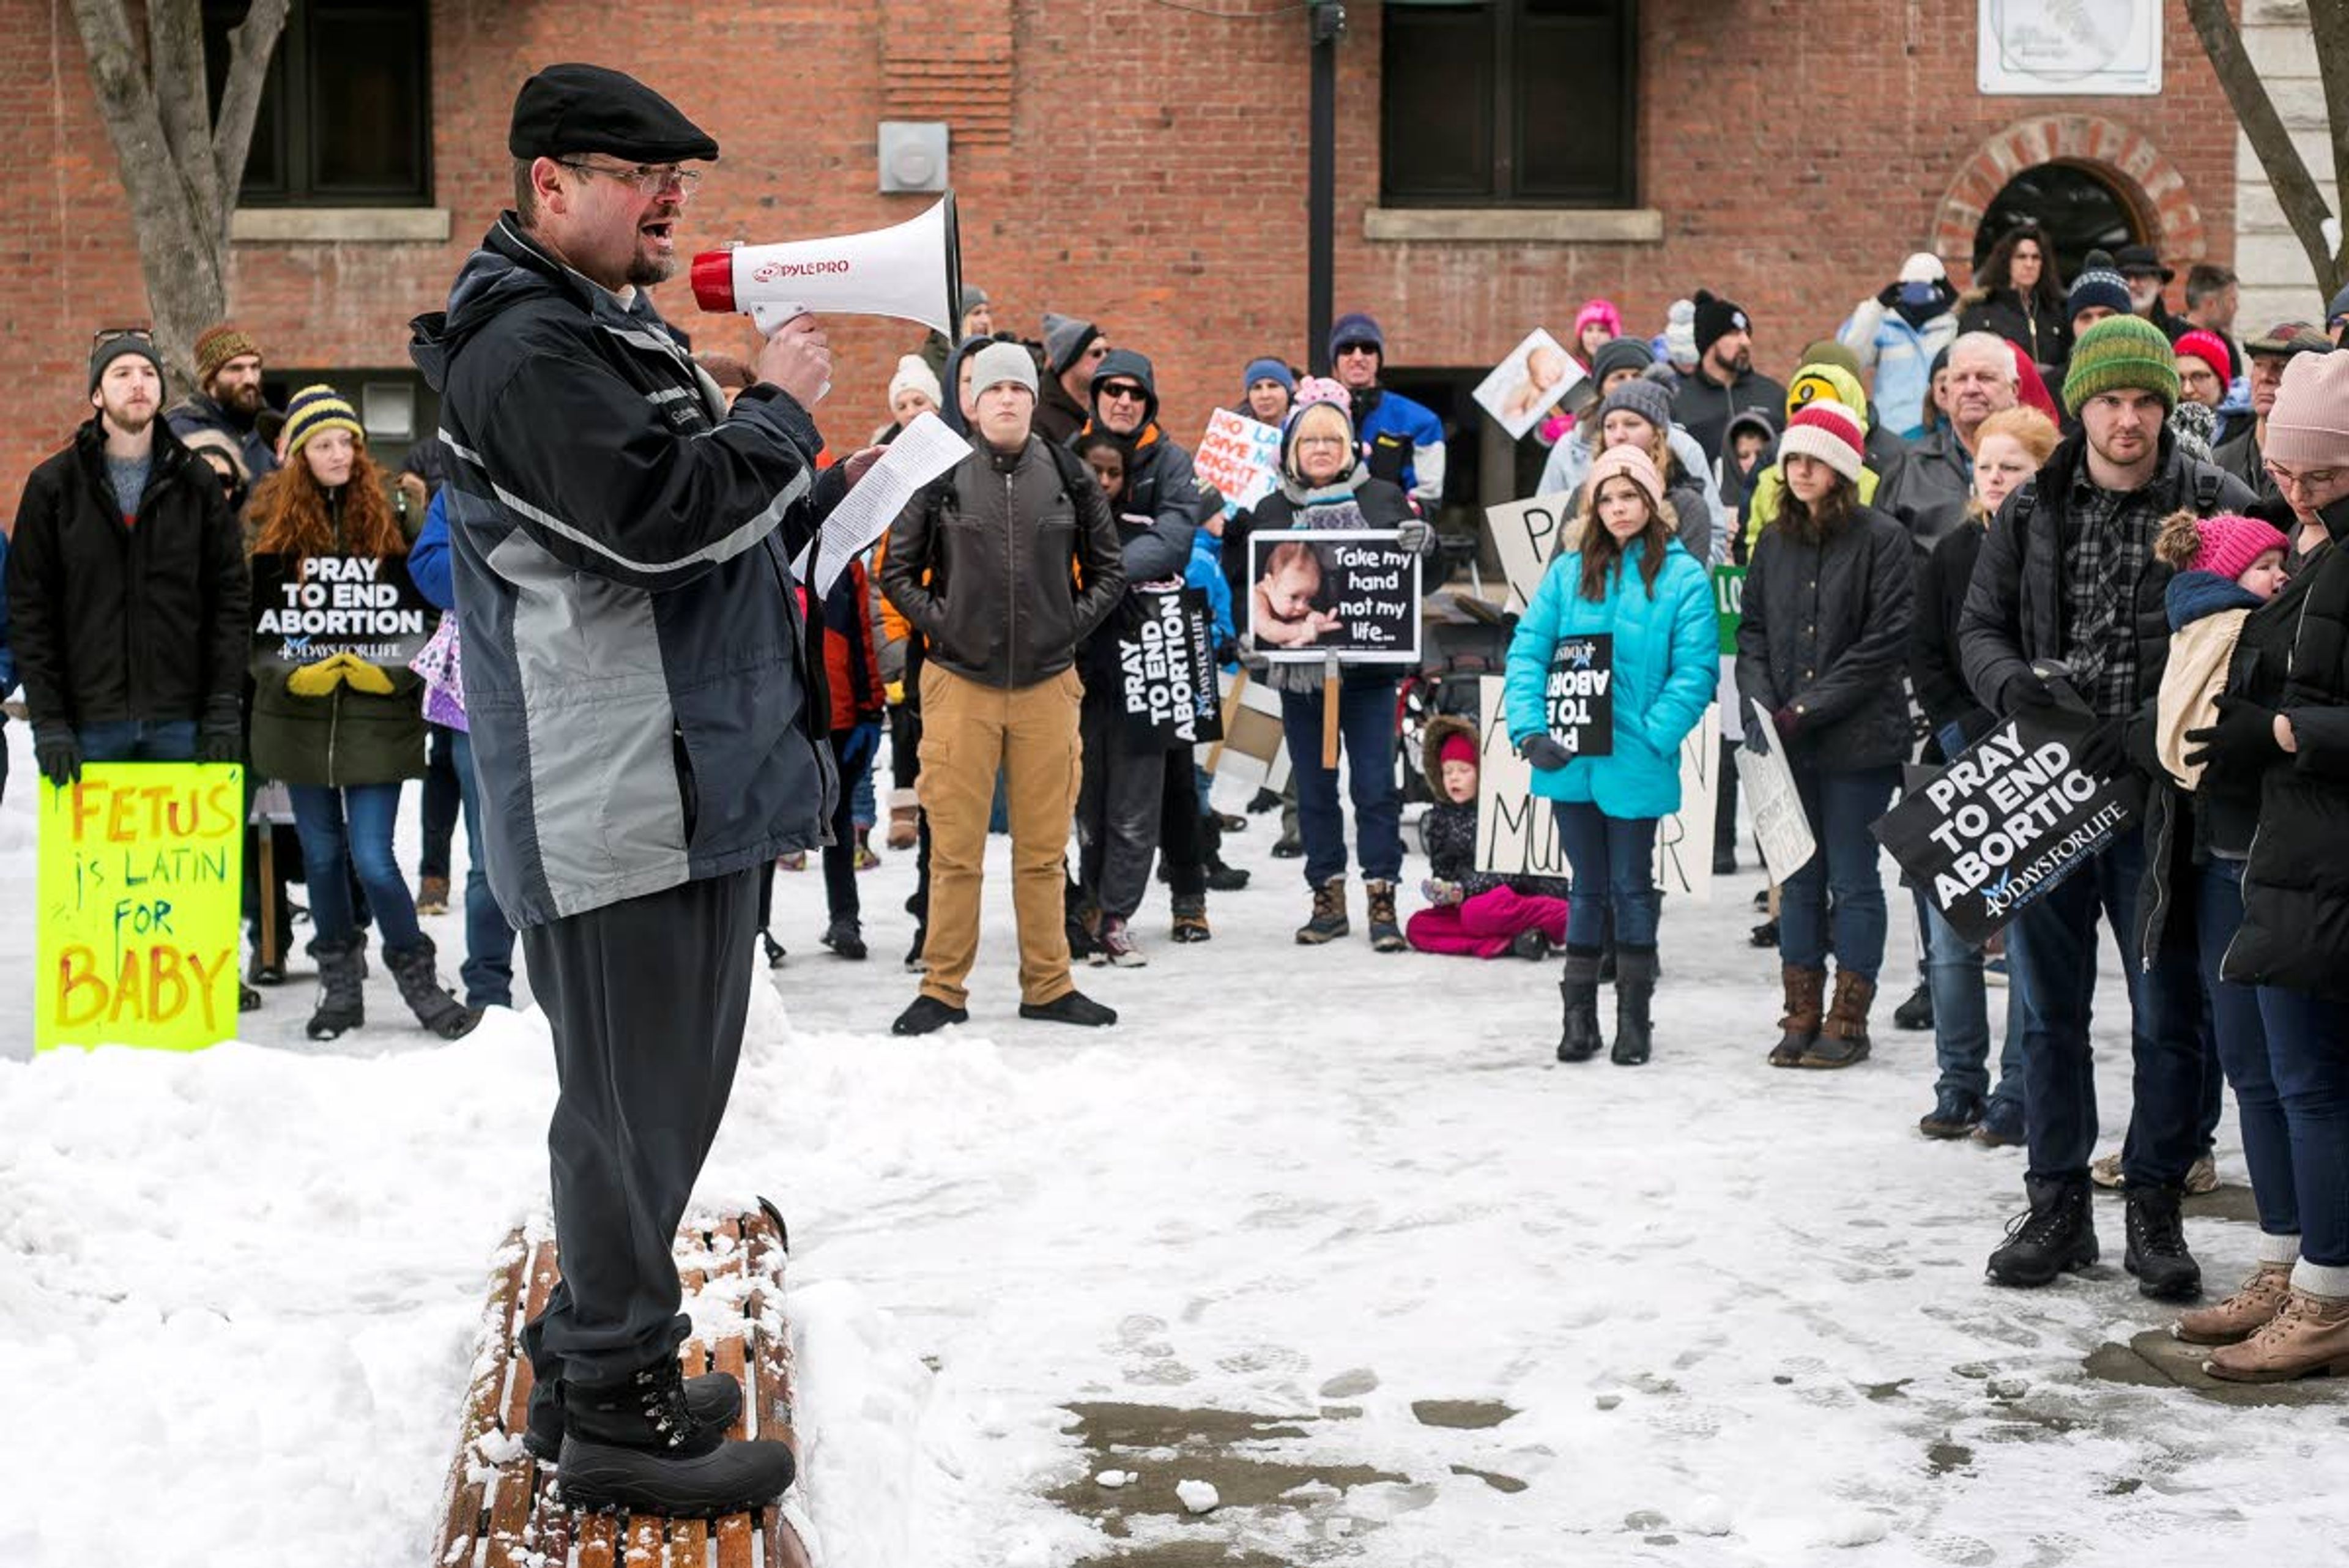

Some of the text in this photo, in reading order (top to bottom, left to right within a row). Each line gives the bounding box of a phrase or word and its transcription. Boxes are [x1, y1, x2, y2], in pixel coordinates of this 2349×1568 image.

[303, 557, 380, 582] PRAY
[1335, 546, 1412, 570] Take my
[1348, 571, 1399, 592] hand
[281, 583, 398, 608] TO END
[1339, 596, 1406, 620] not my
[256, 609, 424, 634] ABORTION
[1118, 639, 1148, 713] PRAY
[1141, 620, 1172, 726] TO END
[1159, 594, 1197, 742] ABORTION
[1546, 669, 1611, 698] ABOR
[1558, 698, 1592, 725] TO
[1926, 721, 2025, 816] PRAY
[71, 780, 236, 843] FETUS
[1929, 741, 2070, 855] TO END
[1933, 769, 2110, 911] ABORTIO
[125, 845, 225, 886] LATIN
[114, 898, 174, 956] FOR
[54, 944, 232, 1032] BABY
